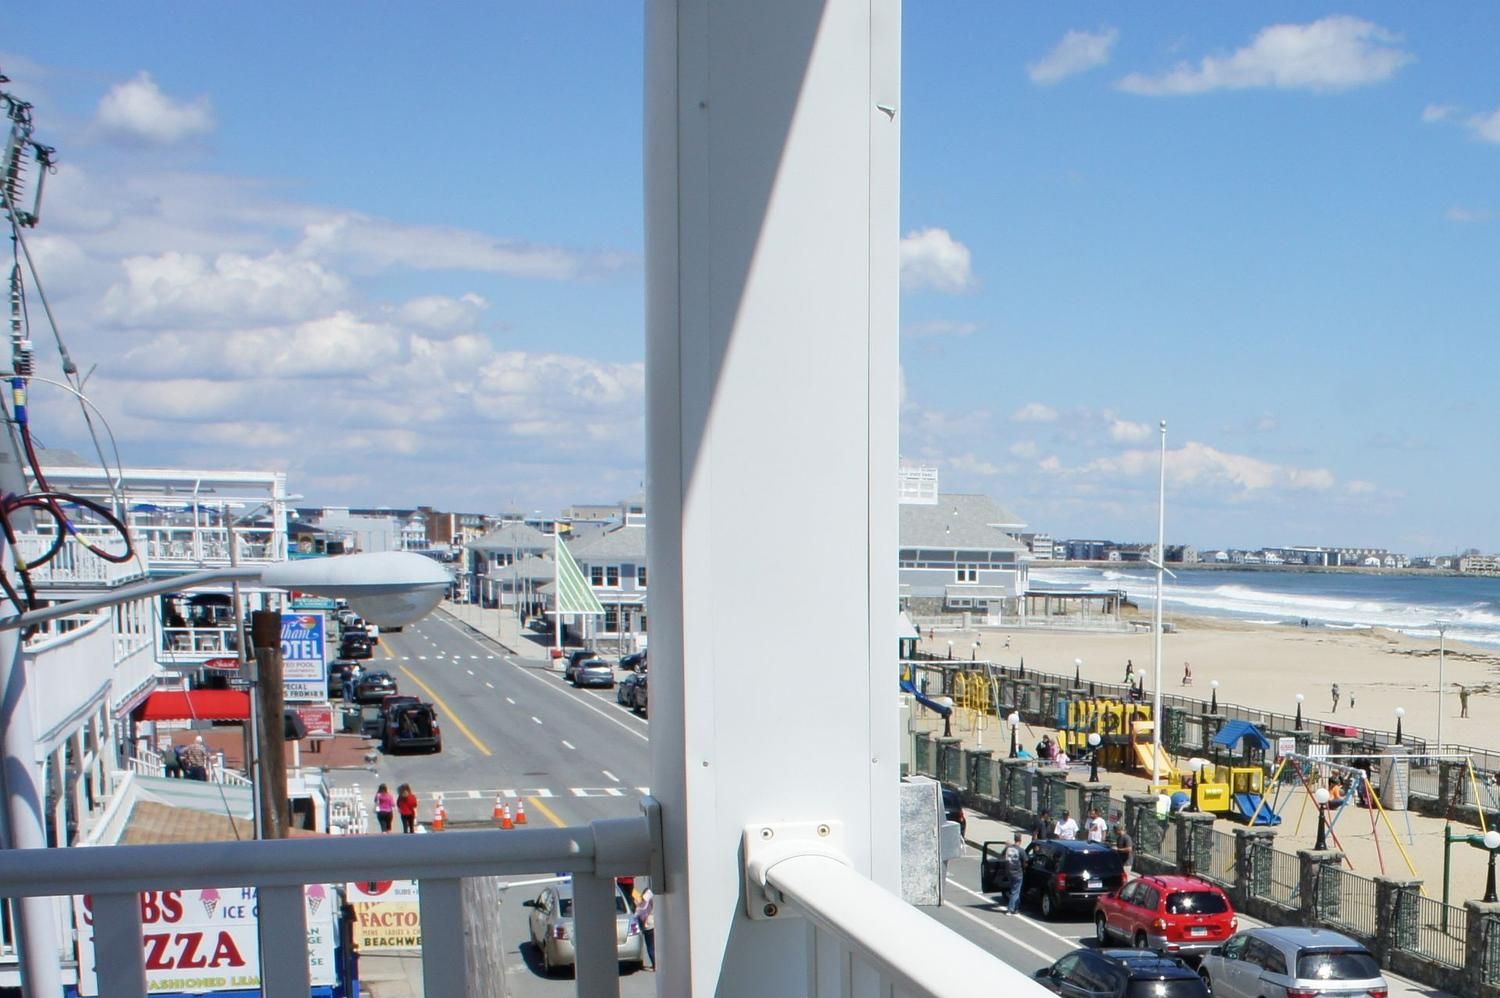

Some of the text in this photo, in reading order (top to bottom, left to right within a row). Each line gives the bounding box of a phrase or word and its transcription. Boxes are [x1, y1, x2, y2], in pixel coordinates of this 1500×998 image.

[281, 640, 322, 658] OTEL
[223, 906, 245, 918] ICE
[359, 911, 418, 927] FACTO
[364, 936, 422, 947] BEACHWE
[143, 931, 246, 970] ZZA
[148, 977, 226, 990] ASHIONED
